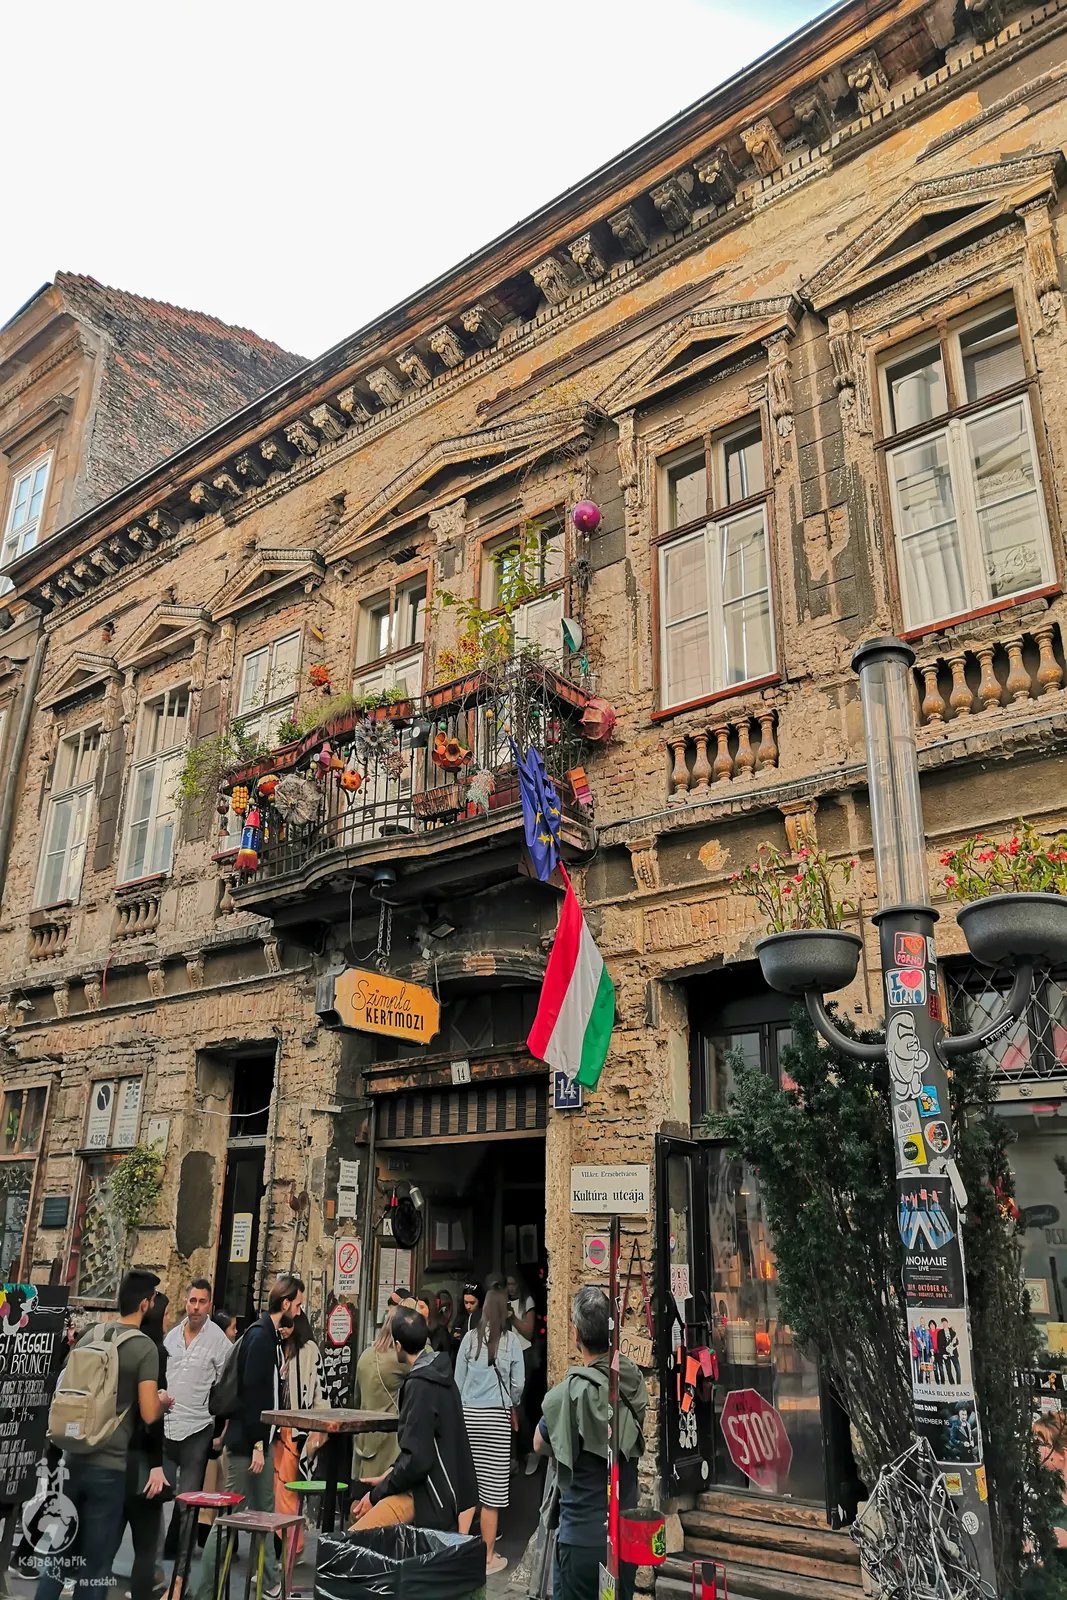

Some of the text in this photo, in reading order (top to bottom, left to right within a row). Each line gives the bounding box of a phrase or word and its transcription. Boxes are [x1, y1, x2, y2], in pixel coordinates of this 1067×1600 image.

[898, 938, 906, 954] I
[897, 954, 923, 966] PORNO
[891, 973, 902, 990] I
[351, 979, 411, 1012] Szimpla
[891, 989, 922, 1003] PORNO
[366, 1007, 424, 1030] KERTMOZI
[457, 1068, 465, 1080] 14
[558, 1078, 577, 1100] 14
[90, 1134, 106, 1146] 4326
[573, 1188, 644, 1203] Kultúra utcája
[905, 1256, 947, 1266] ANOMALIE
[918, 1283, 939, 1292] OKTÓBER
[14, 1333, 55, 1354] REGGELI
[10, 1354, 52, 1375] BRUNCH
[727, 1411, 780, 1465] STOP
